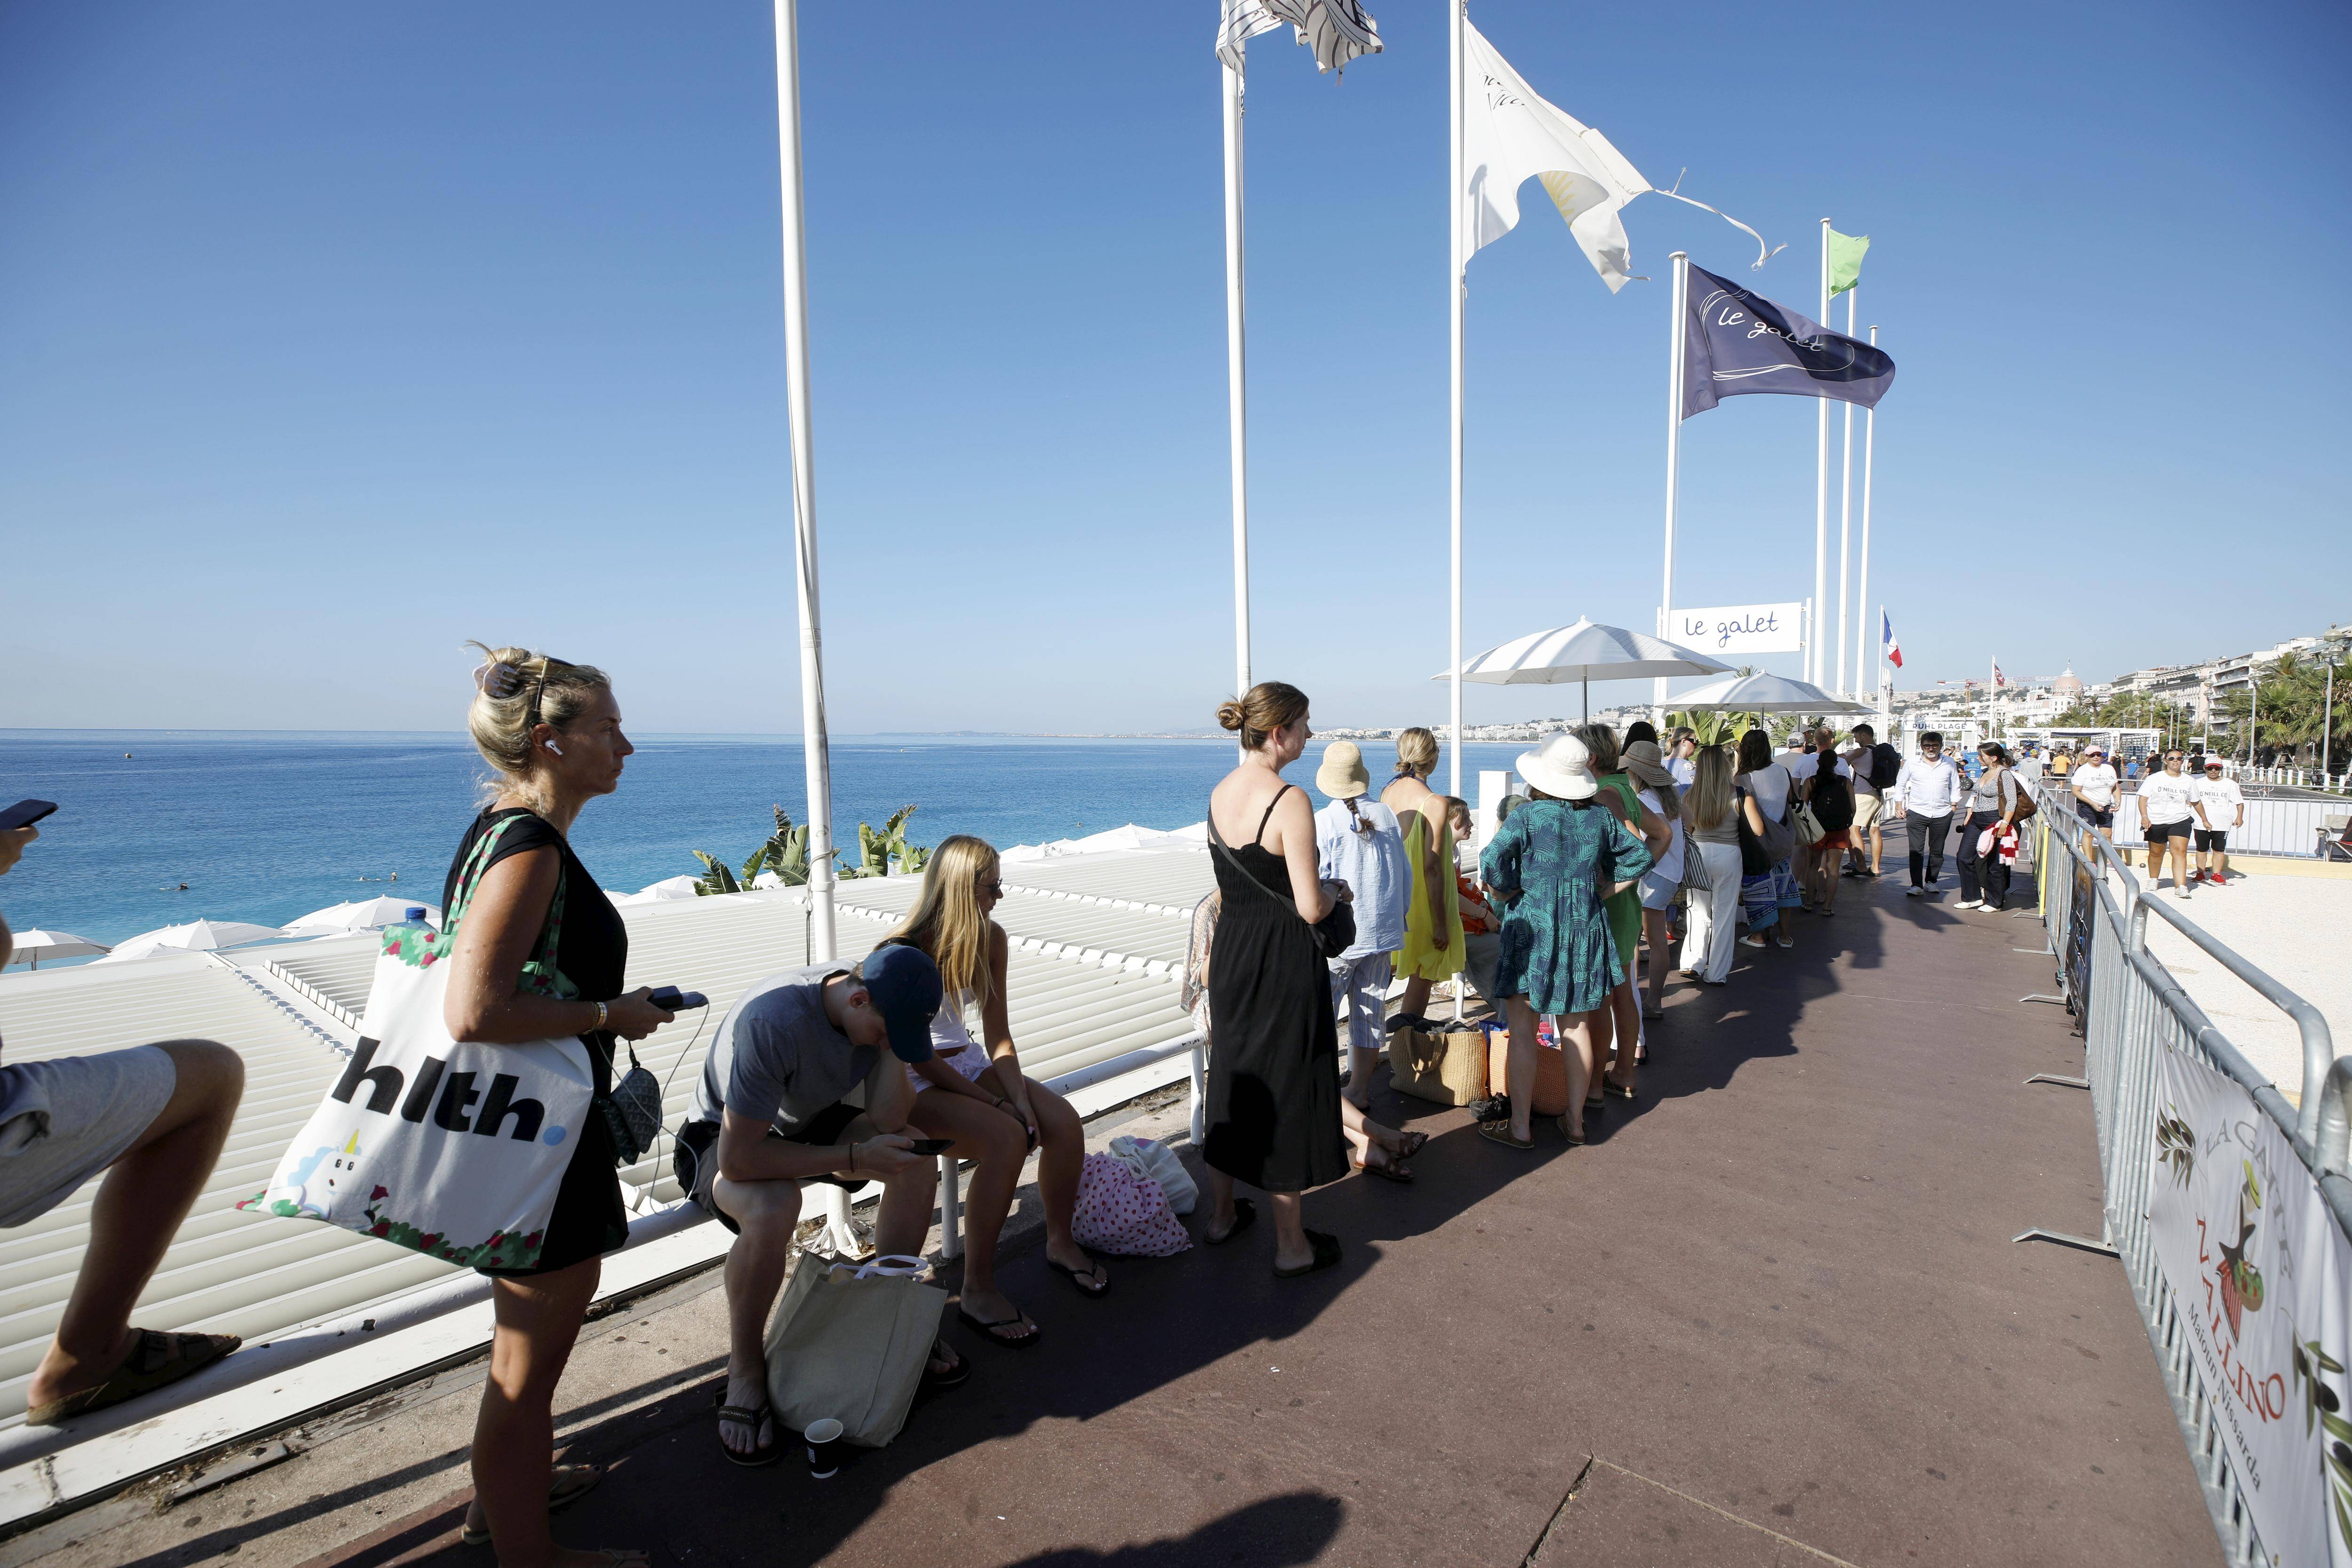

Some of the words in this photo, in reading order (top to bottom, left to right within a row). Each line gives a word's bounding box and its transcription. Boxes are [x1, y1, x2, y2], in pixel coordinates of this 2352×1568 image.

[1718, 307, 1745, 326] le
[1686, 617, 1708, 636] le
[1717, 611, 1779, 648] galet
[2205, 1118, 2232, 1159] LA
[2195, 1212, 2286, 1424] NALLINO
[2188, 1302, 2217, 1380] Maioun
[2217, 1377, 2261, 1494] Nissarda
